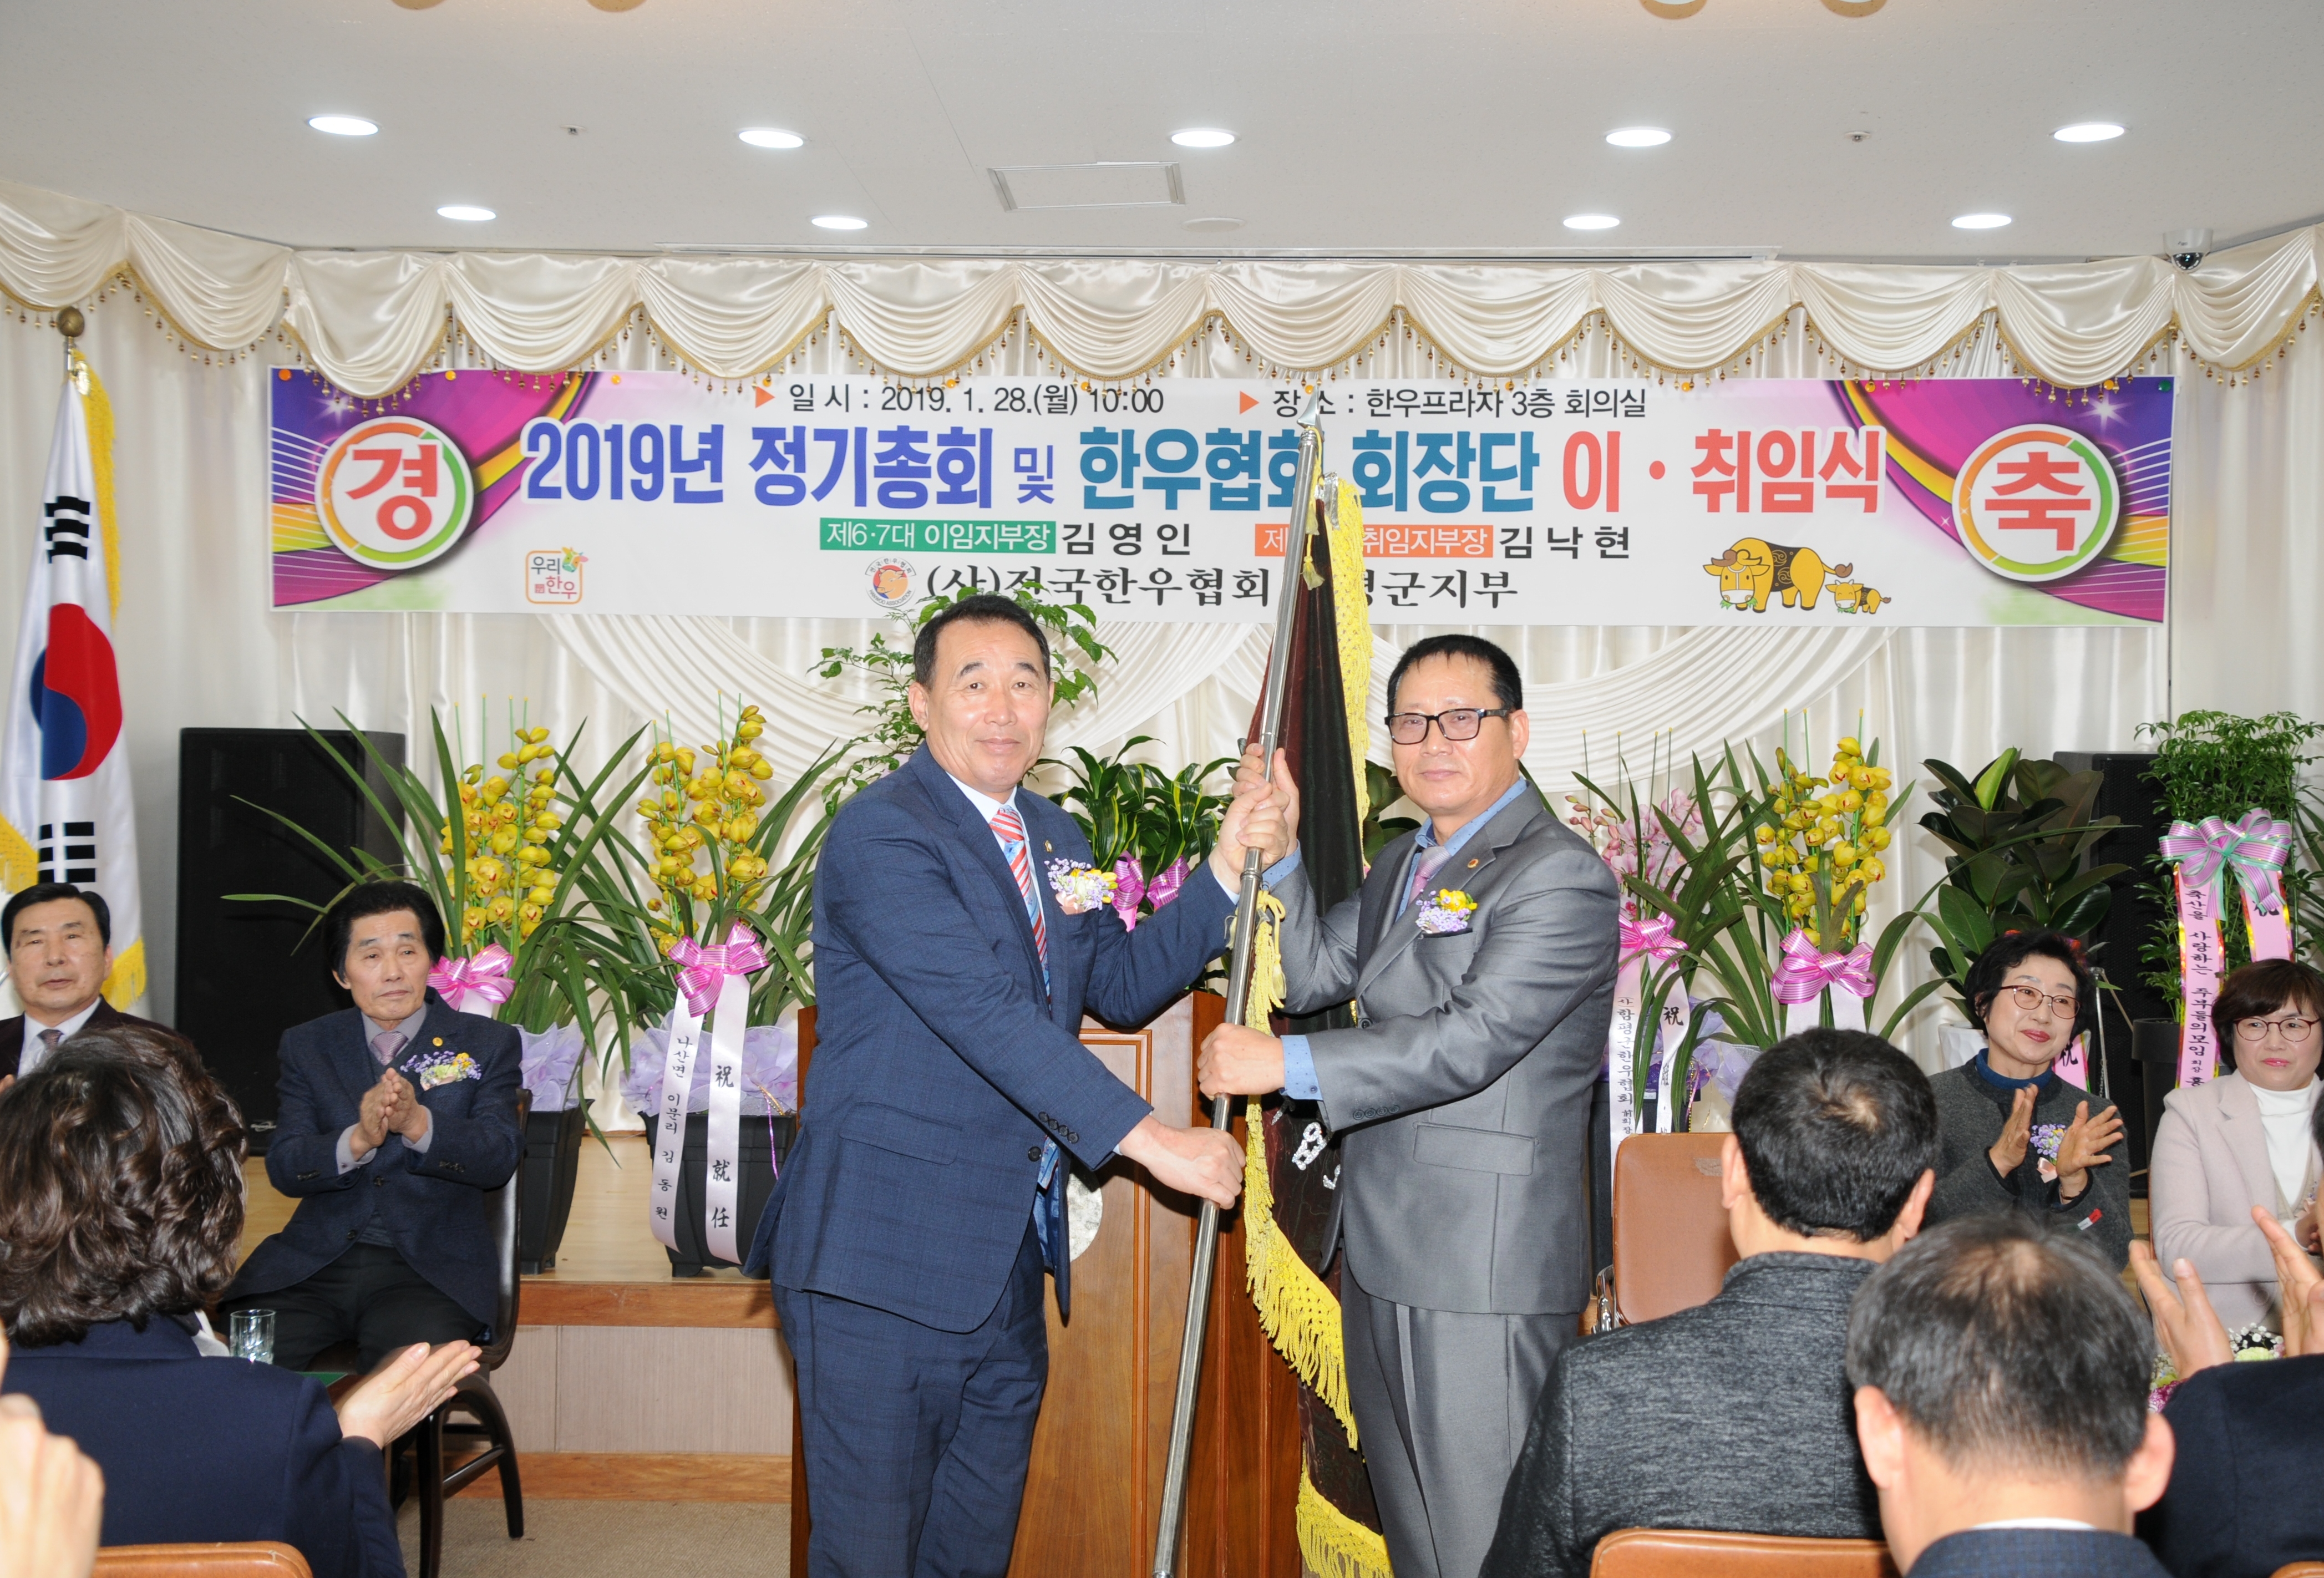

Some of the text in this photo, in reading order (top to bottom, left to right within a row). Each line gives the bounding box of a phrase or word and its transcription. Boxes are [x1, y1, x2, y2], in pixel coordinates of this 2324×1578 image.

[881, 387, 951, 413] 2019.
[1090, 388, 1164, 414] 10:00
[1366, 388, 1504, 419] 한우프라자
[1511, 389, 1555, 419] 3층
[1565, 388, 1646, 418] 회의실
[527, 422, 724, 504] 2019년
[749, 424, 993, 509] 정기총회
[1013, 444, 1055, 505] 및
[1352, 430, 1540, 513] 회장단
[1563, 431, 1621, 513] 이
[1691, 428, 1881, 514] 취임식
[346, 444, 438, 540] 경
[1985, 452, 2091, 551] 축
[925, 522, 1050, 551] 이임지부장
[1363, 527, 1487, 554] 취임지부장
[531, 556, 560, 575] 우리
[545, 576, 577, 600] 한우
[2185, 890, 2208, 920] 축산을
[2188, 931, 2213, 975] 사랑하는
[1664, 1007, 1684, 1026] 祝
[672, 1036, 693, 1078] 나산면
[665, 1093, 681, 1135] 이문리
